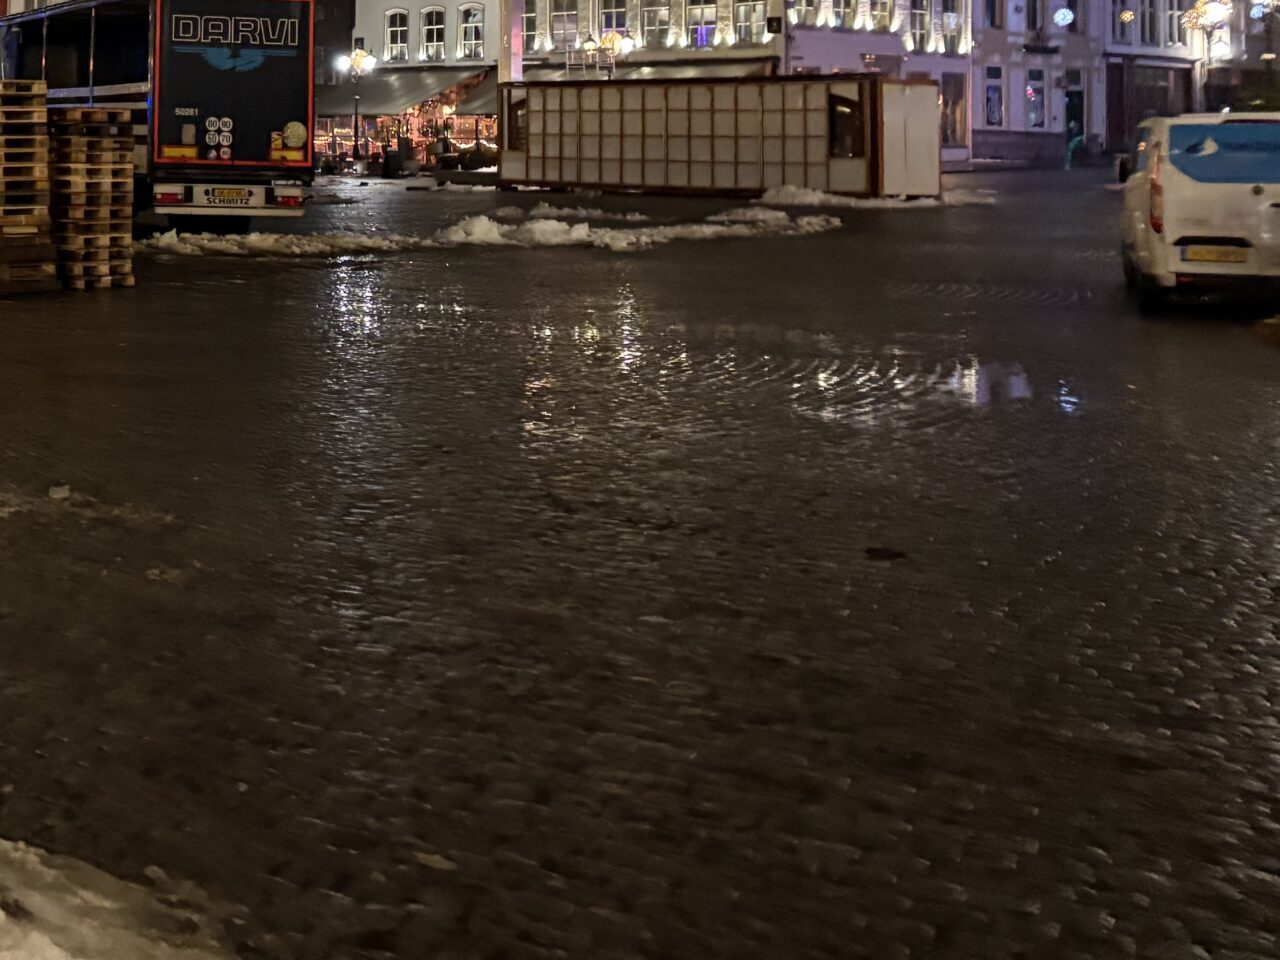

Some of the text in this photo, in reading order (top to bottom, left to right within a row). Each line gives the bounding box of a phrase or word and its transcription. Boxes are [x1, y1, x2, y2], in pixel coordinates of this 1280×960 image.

[172, 14, 299, 46] DARVI
[208, 120, 231, 129] 80 90
[221, 134, 231, 143] 70
[206, 197, 250, 205] SCHMITZ
